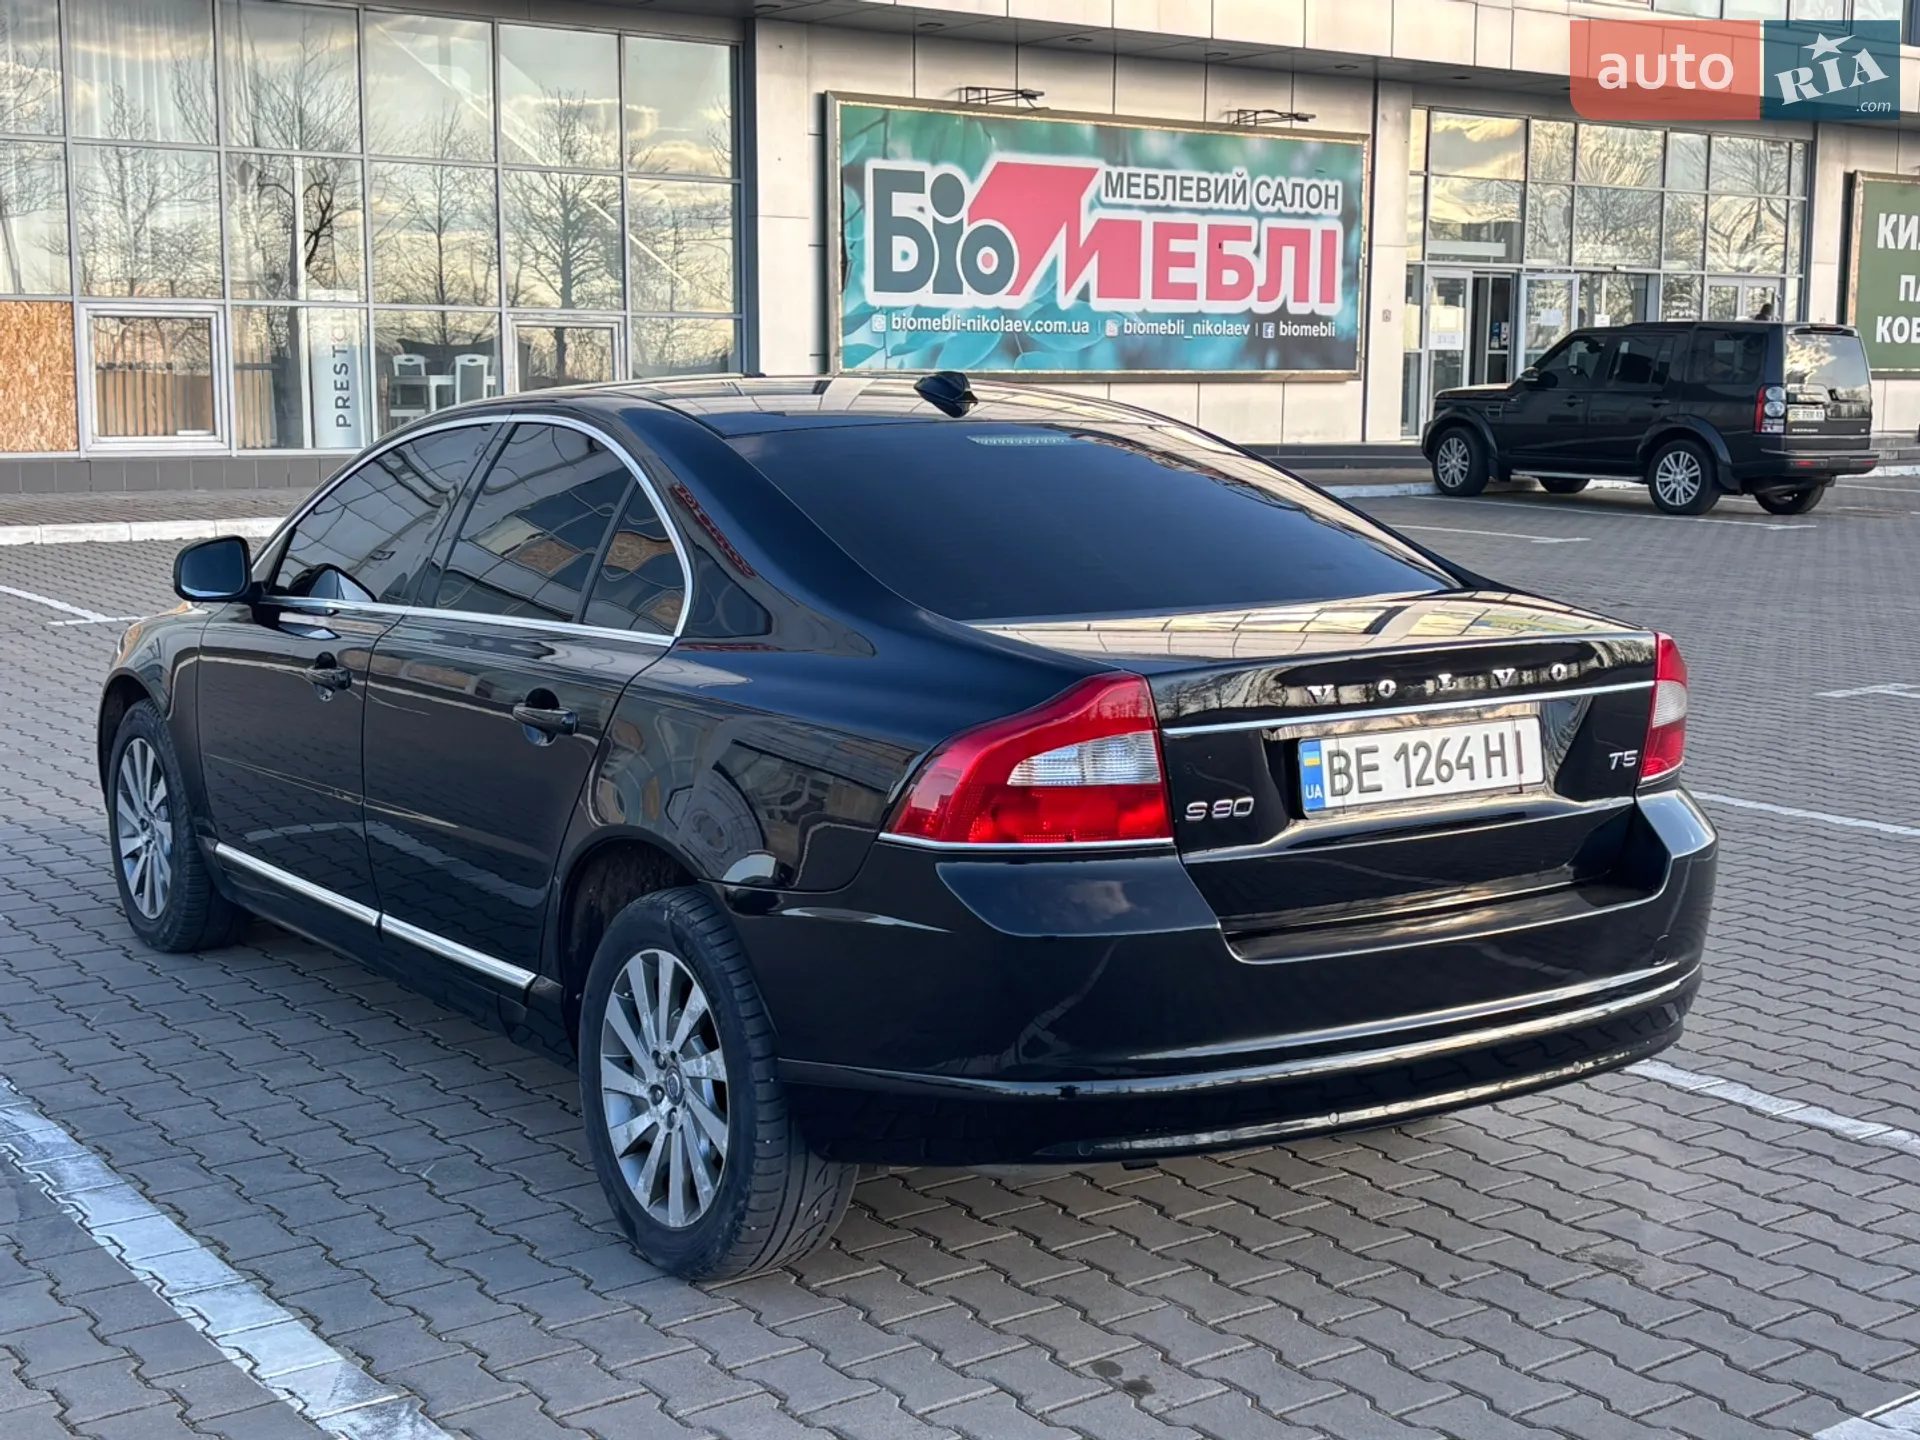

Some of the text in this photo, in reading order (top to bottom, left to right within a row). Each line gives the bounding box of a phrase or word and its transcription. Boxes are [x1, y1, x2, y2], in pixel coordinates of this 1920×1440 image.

[1104, 171, 1339, 210] МЕБЛЕВИЙ САЛОН
[1877, 213, 1920, 251] КИ
[891, 314, 1336, 339] biomebli-nikolaev.com.ua biomebli_nikolaev biomebli
[1307, 663, 1567, 703] VOLVO
[1327, 744, 1383, 797] BE
[1394, 735, 1475, 789] 1264
[1609, 750, 1639, 770] T5
[1305, 784, 1323, 799] UA
[1184, 796, 1255, 823] S80
